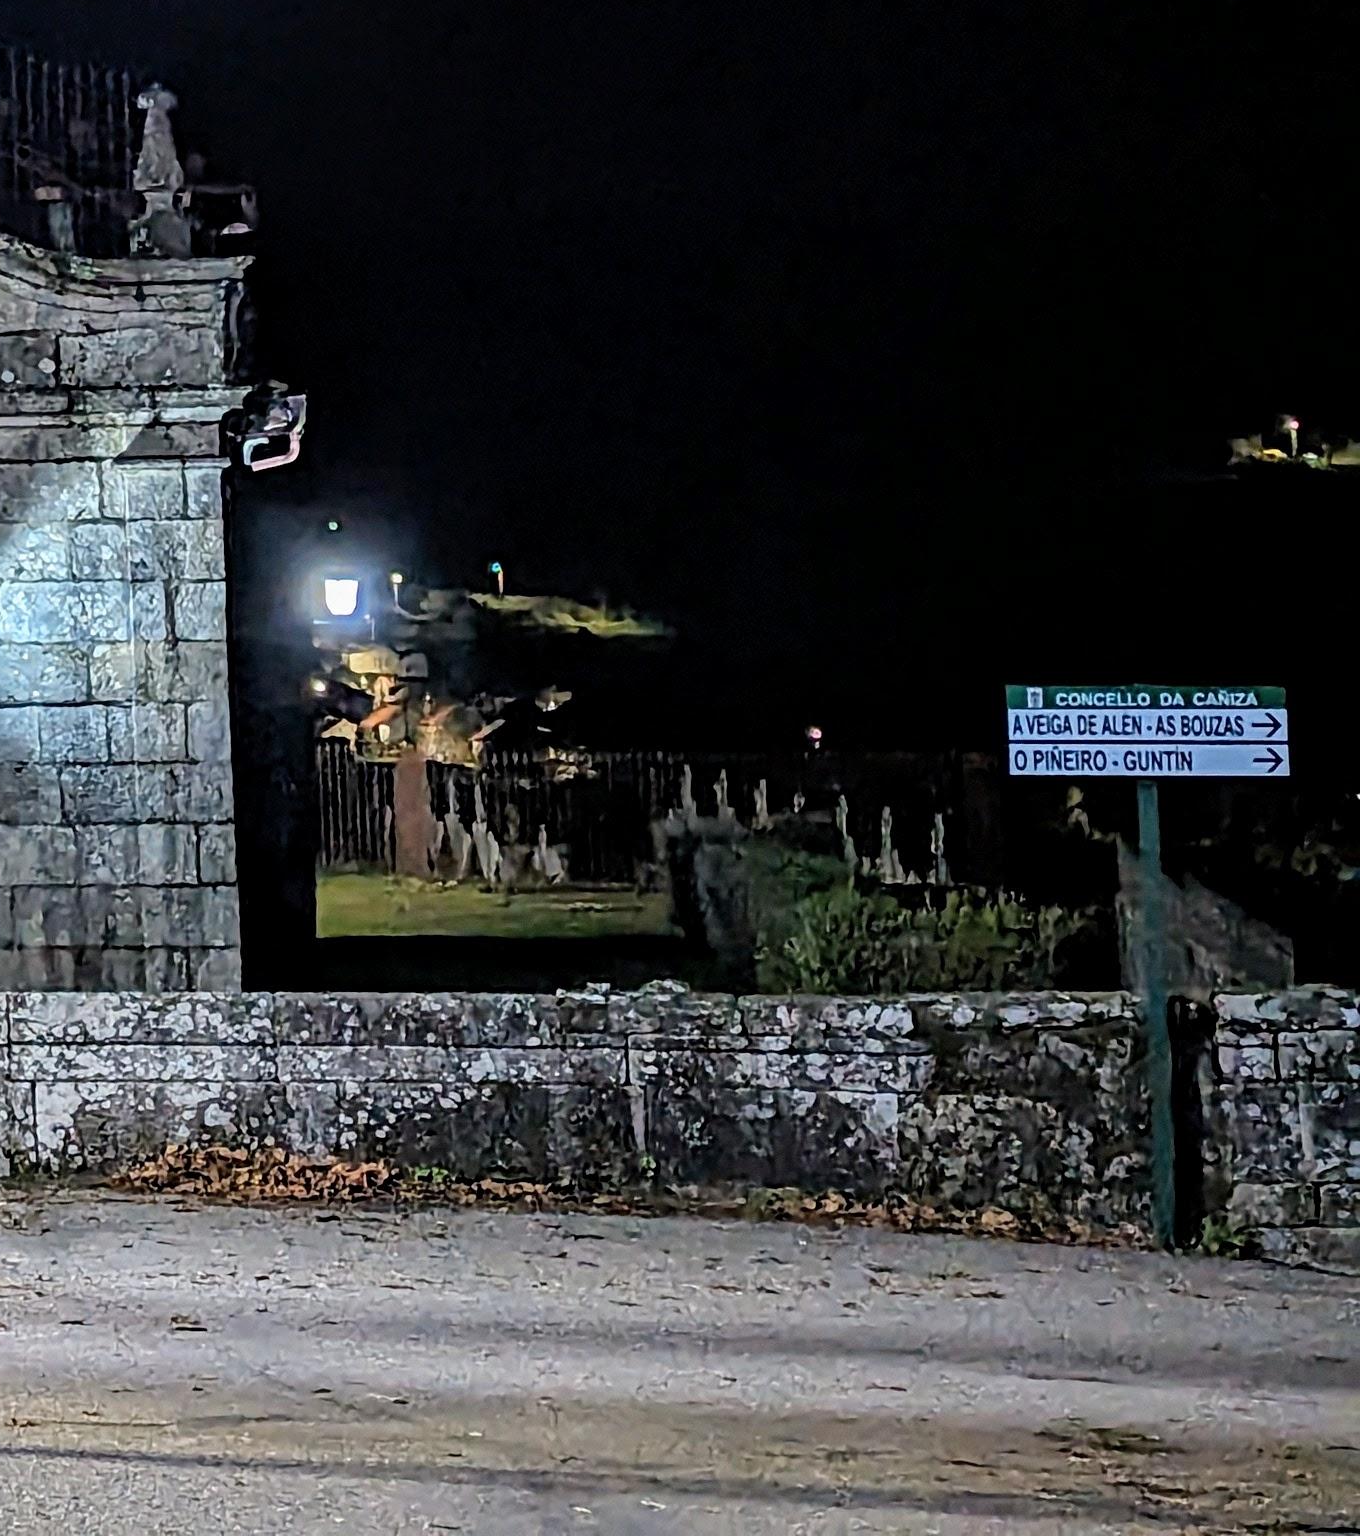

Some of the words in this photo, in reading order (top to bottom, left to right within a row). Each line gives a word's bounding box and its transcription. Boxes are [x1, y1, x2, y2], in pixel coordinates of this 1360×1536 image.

[1056, 692, 1150, 706] CONCELLO
[1160, 692, 1184, 706] DA
[1193, 689, 1258, 706] CAÑIZA
[1013, 714, 1023, 735] A
[1026, 714, 1073, 735] VEIGA
[1077, 714, 1098, 735] DE
[1155, 715, 1176, 736] AS
[1180, 715, 1245, 736] BOUZAS
[1014, 749, 1028, 771] O
[1033, 746, 1107, 771] PIÑEIRO
[1123, 746, 1193, 772] GUNTÍN
